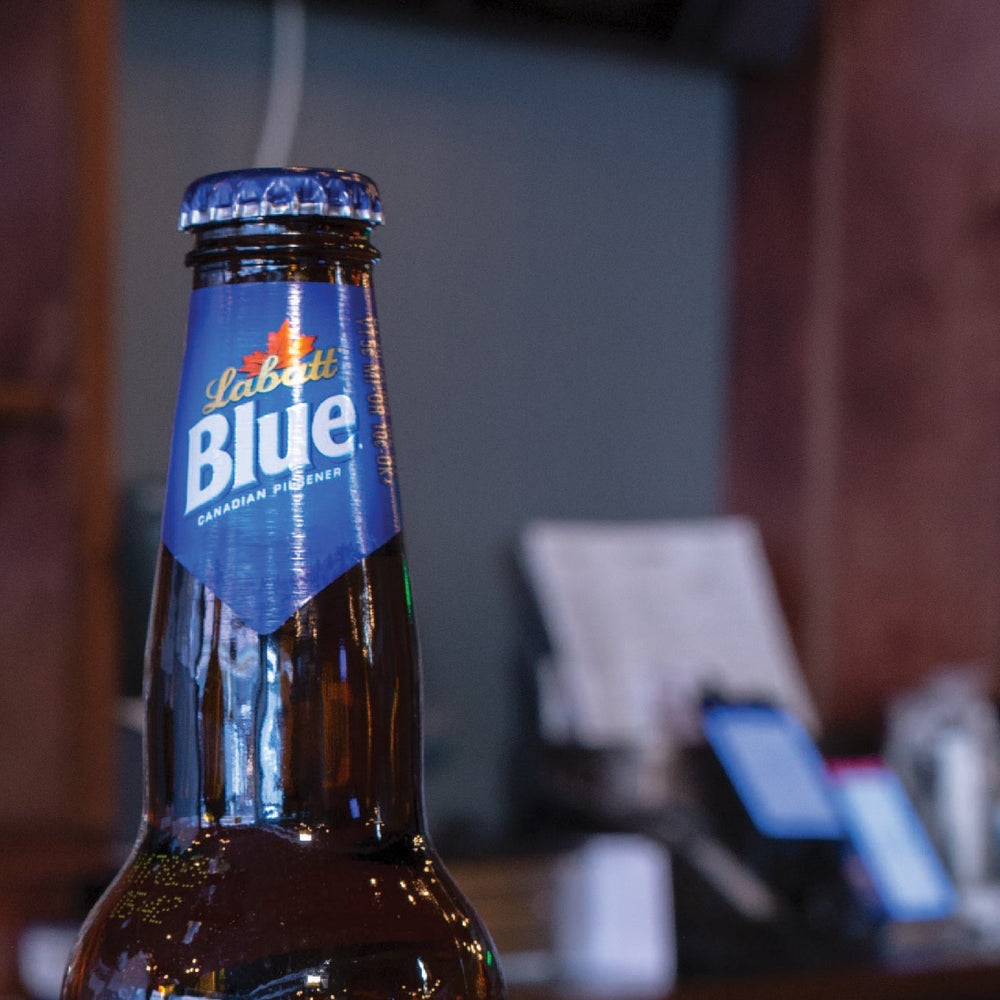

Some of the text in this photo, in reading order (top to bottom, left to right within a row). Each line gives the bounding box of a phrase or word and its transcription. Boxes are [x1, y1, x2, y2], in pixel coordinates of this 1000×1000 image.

[202, 348, 339, 414] Labatt
[184, 394, 358, 516] Blue
[197, 466, 342, 527] CANADIAN PILSENER
